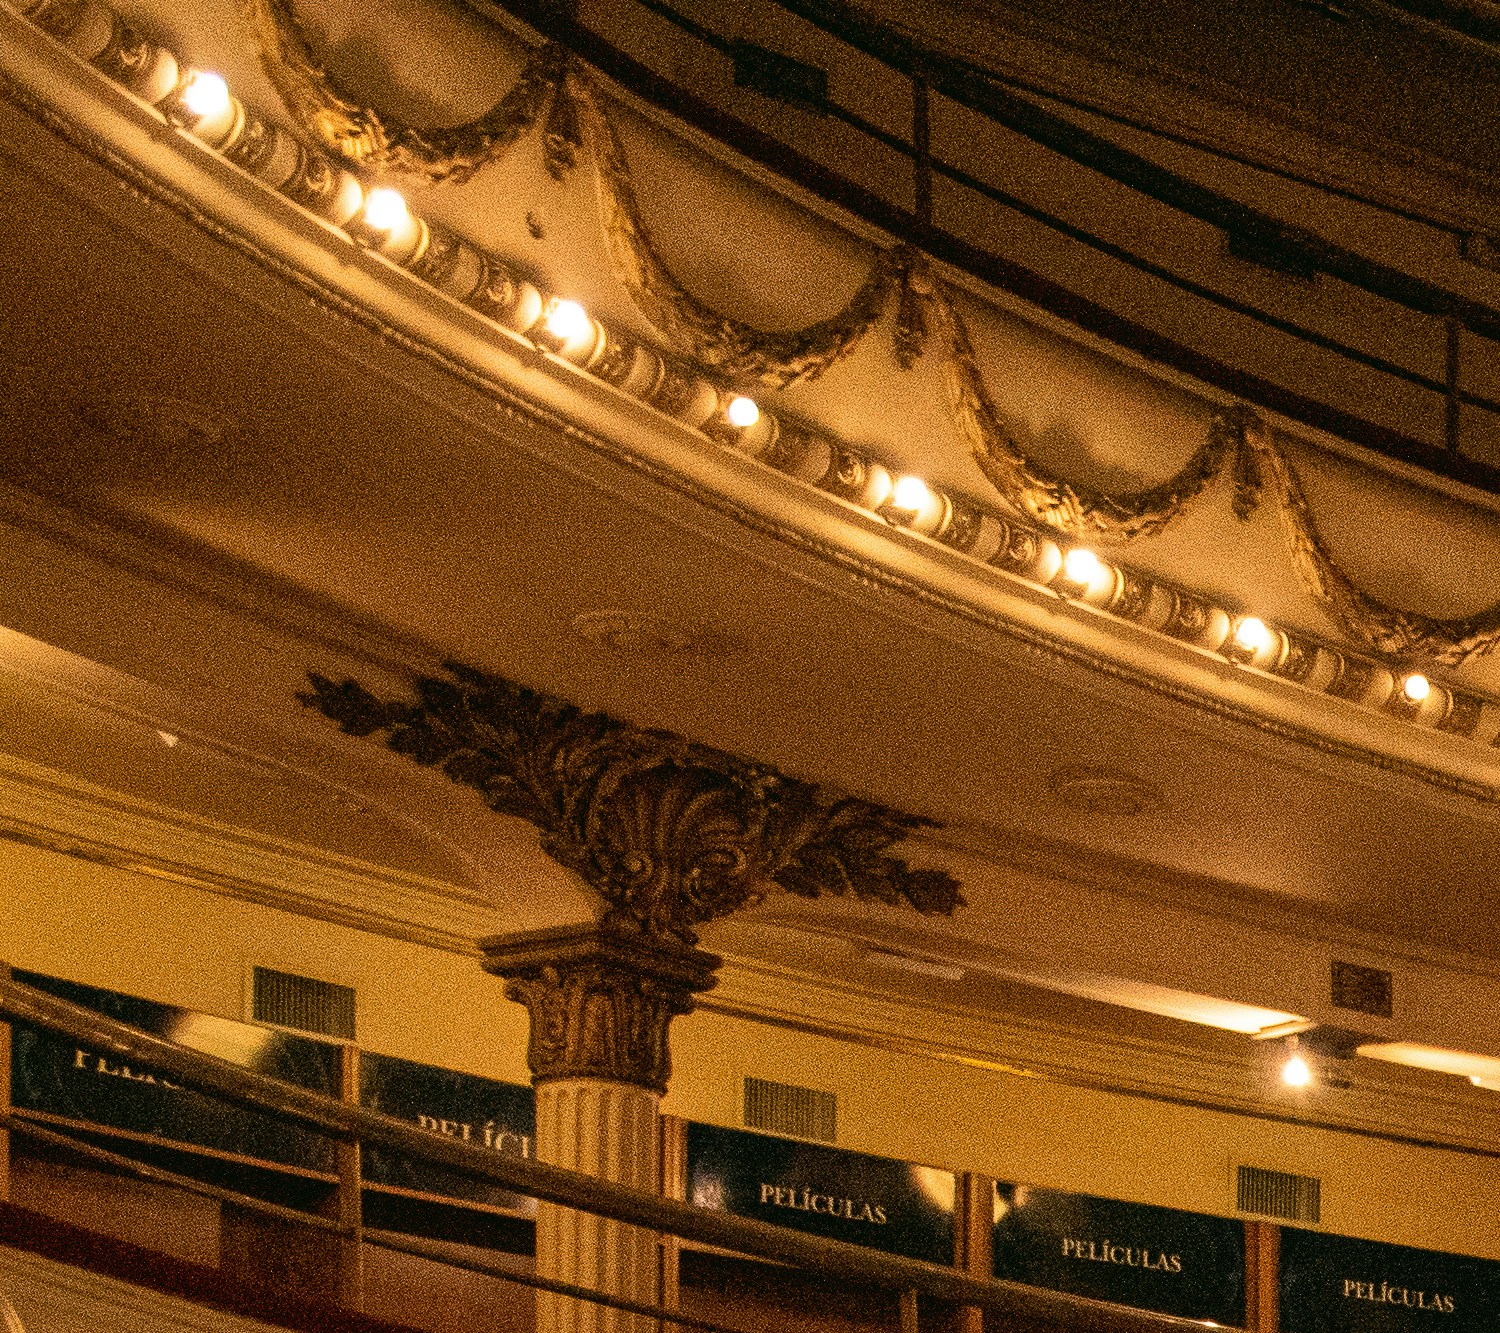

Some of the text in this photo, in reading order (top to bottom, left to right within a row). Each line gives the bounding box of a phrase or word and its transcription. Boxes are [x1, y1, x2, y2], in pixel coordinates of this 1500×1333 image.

[760, 1183, 887, 1226] PELÍCULAS
[1062, 1236, 1182, 1274] PELÍCULAS
[1343, 1277, 1455, 1314] PELÍCULAS
